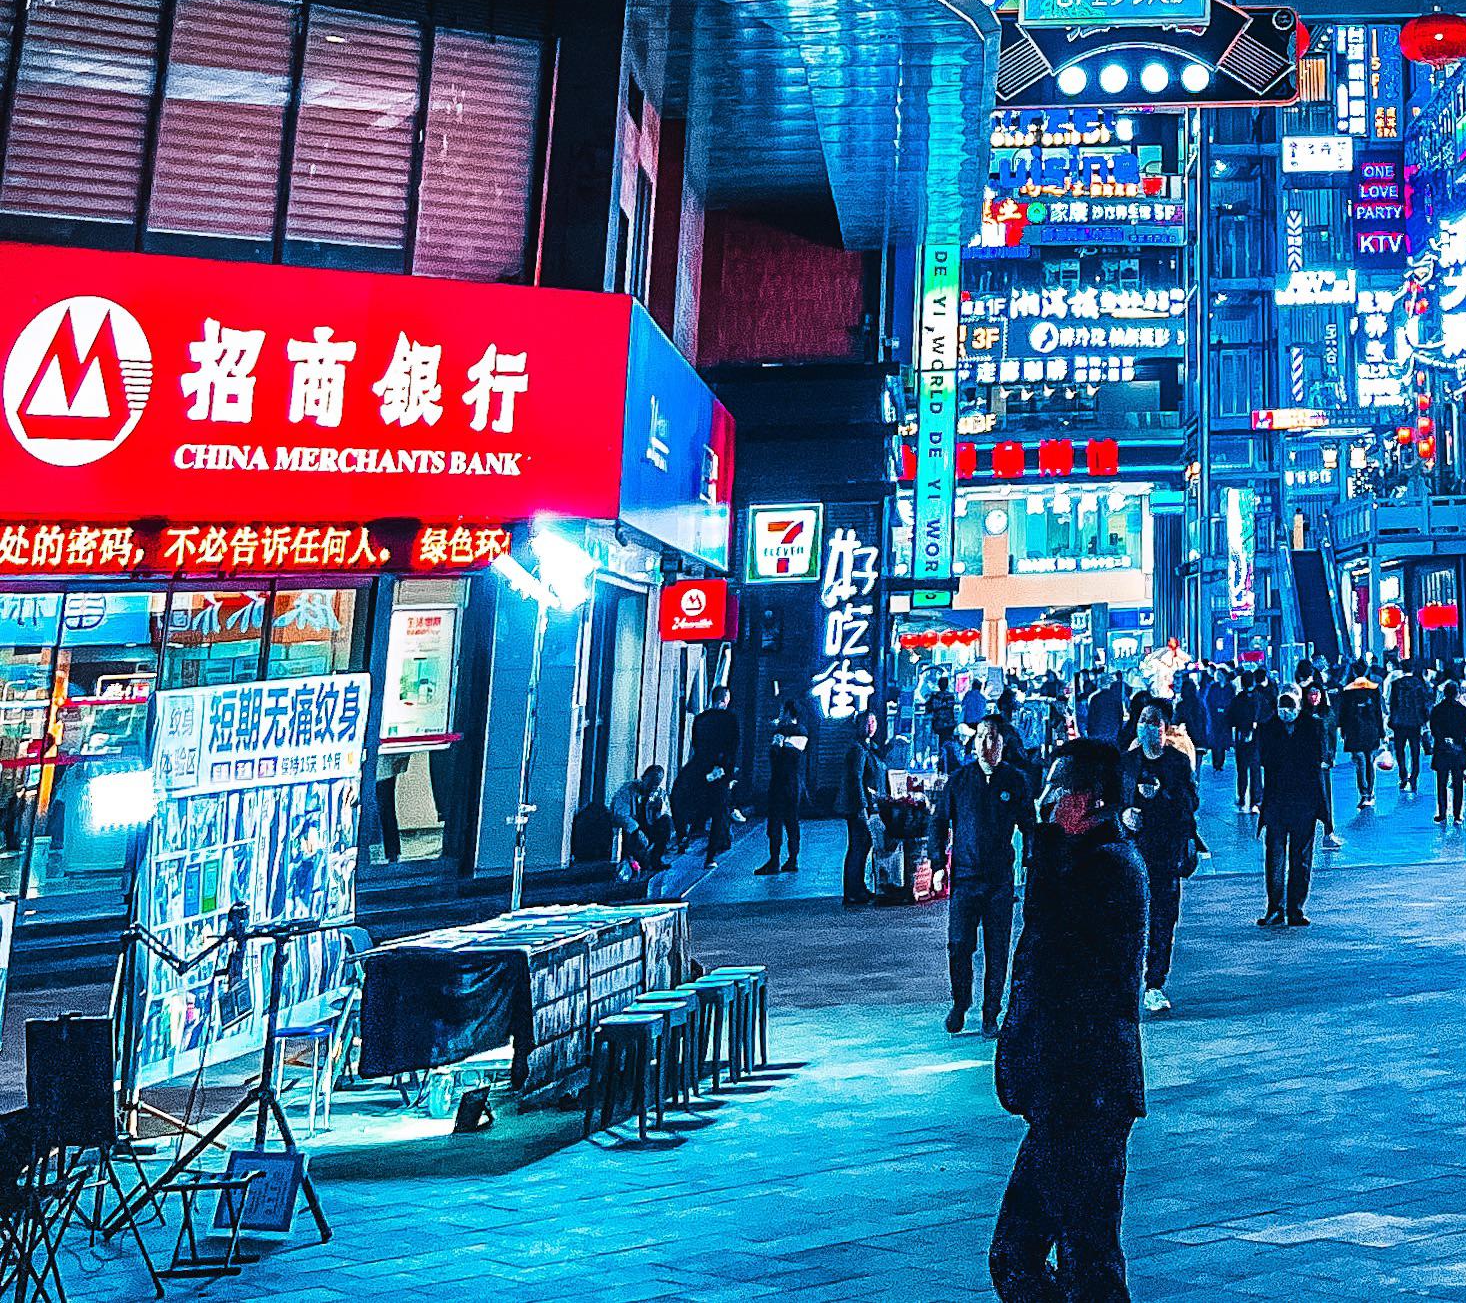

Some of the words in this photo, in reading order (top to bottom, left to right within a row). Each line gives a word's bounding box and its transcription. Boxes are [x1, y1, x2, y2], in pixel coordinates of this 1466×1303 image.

[1363, 165, 1395, 178] ONE
[1360, 184, 1399, 198] LOVE
[1356, 205, 1403, 220] PARTY
[1360, 234, 1404, 254] KTV
[933, 250, 948, 277] DE
[933, 296, 948, 317] YI
[972, 326, 1000, 349] 3F
[180, 316, 530, 436] 招商銀行
[930, 335, 946, 415] WORLD
[174, 443, 269, 473] CHINA
[273, 445, 447, 476] MERCHANTS
[449, 448, 523, 477] BANK
[929, 431, 944, 460] DE
[165, 527, 393, 566] 不必告诉任何人。
[812, 526, 879, 719] 好吃街
[168, 703, 195, 737] 纹身
[208, 683, 362, 754] 短期无痛纹身
